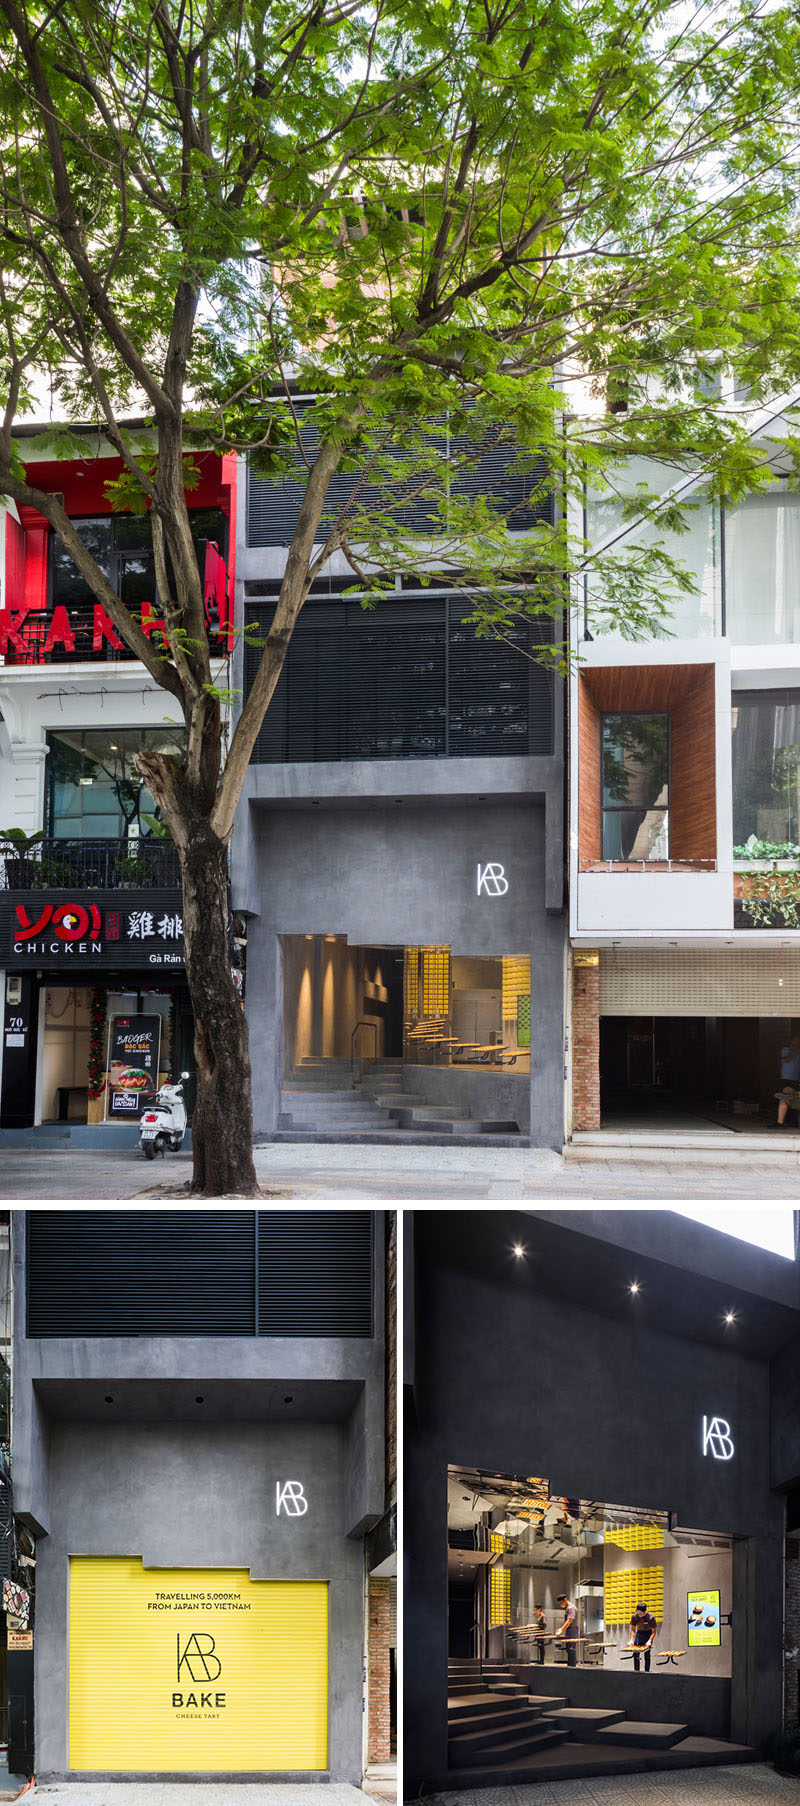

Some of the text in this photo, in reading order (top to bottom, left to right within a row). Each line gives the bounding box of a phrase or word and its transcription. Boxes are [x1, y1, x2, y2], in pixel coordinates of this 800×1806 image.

[14, 943, 101, 953] CHICKEN
[149, 955, 162, 963] Gà
[164, 954, 181, 963] Rán
[9, 1017, 23, 1027] 70
[207, 1593, 241, 1601] 5,000KM
[172, 1693, 226, 1708] BAKE
